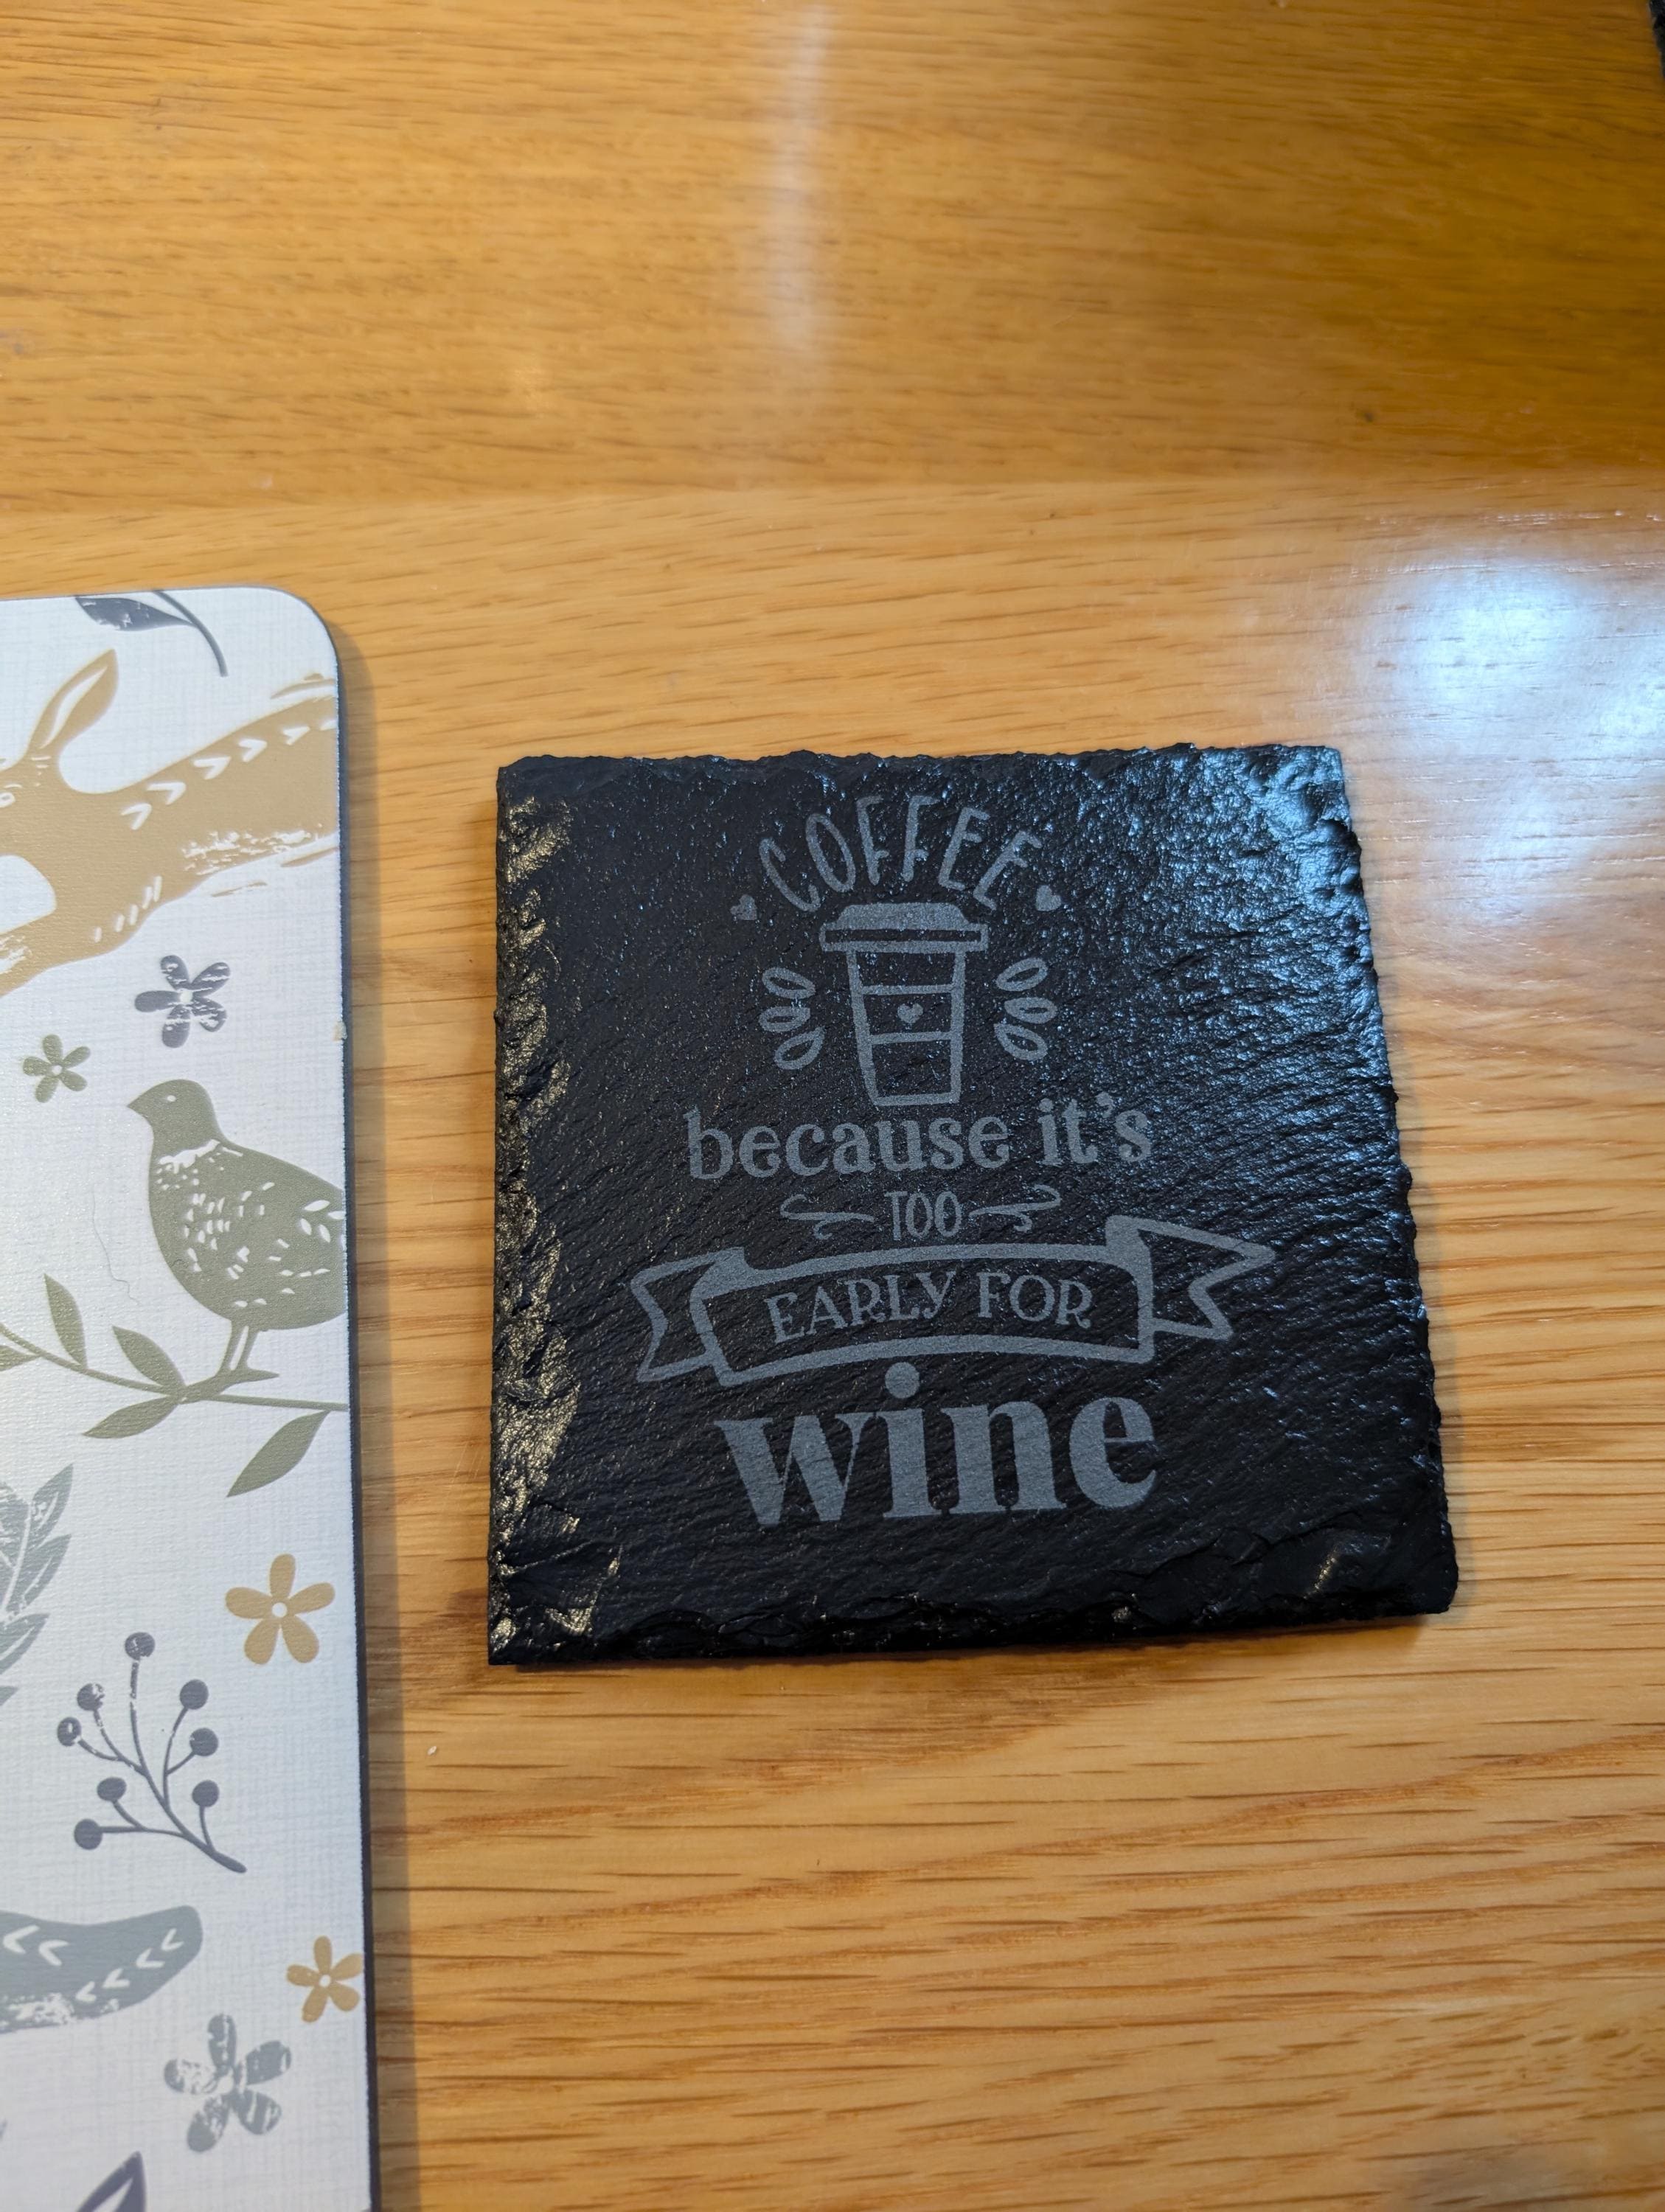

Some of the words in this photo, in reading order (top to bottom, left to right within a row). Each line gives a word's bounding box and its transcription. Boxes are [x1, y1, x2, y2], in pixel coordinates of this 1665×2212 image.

[758, 795, 1041, 912] COFFEE
[684, 1106, 1010, 1180] because
[1037, 1091, 1155, 1166] it's
[886, 1190, 963, 1242] TOO
[764, 1270, 954, 1340] EARLY
[979, 1273, 1093, 1329] FOR
[713, 1361, 1158, 1526] wine
